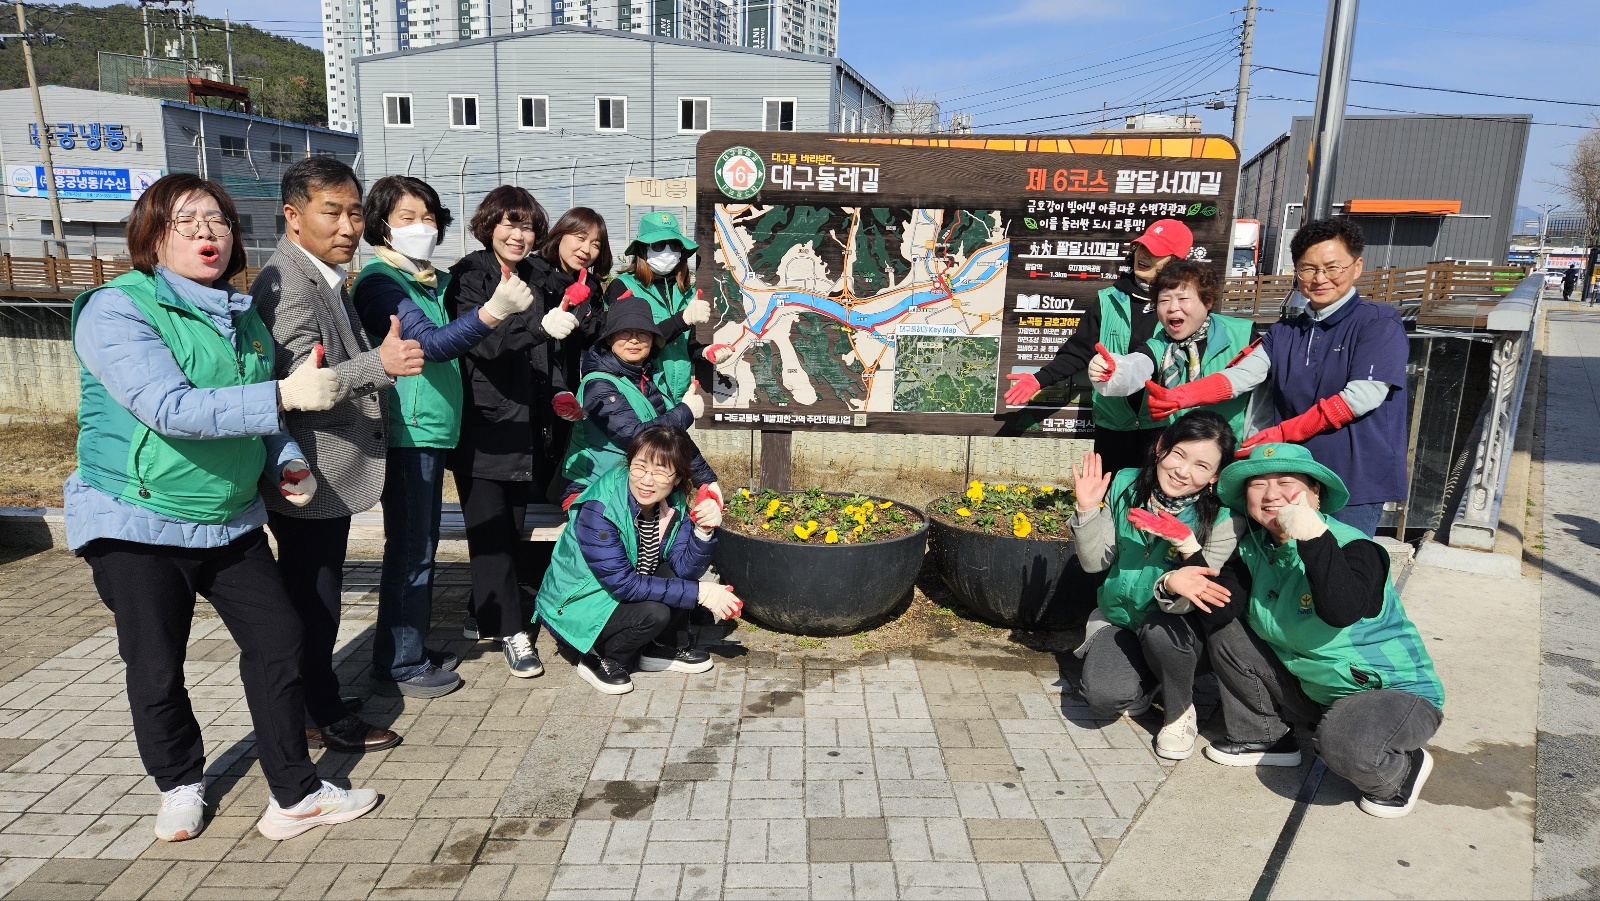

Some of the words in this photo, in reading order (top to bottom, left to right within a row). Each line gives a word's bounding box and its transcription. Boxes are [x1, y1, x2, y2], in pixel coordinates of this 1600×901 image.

[771, 153, 797, 165] 대구를
[801, 153, 835, 165] 바라본다
[736, 166, 746, 183] 6
[771, 165, 879, 192] 대구둘레길
[1025, 168, 1047, 191] 제
[1053, 168, 1109, 192] 6코스
[1115, 169, 1222, 196] 팔달서재길
[1027, 200, 1064, 213] 금호강이
[1098, 201, 1136, 215] 아름다운
[1139, 202, 1187, 216] 수변경관과
[1039, 217, 1058, 230] 이를
[1061, 217, 1090, 231] 둘러싼
[1092, 217, 1111, 230] 도시
[1114, 218, 1146, 232] 교통망!
[1057, 241, 1119, 257] 팔달서재길
[1042, 295, 1074, 311] Story
[1018, 317, 1042, 326] 노곡동
[1043, 418, 1095, 429] 대구광역시
